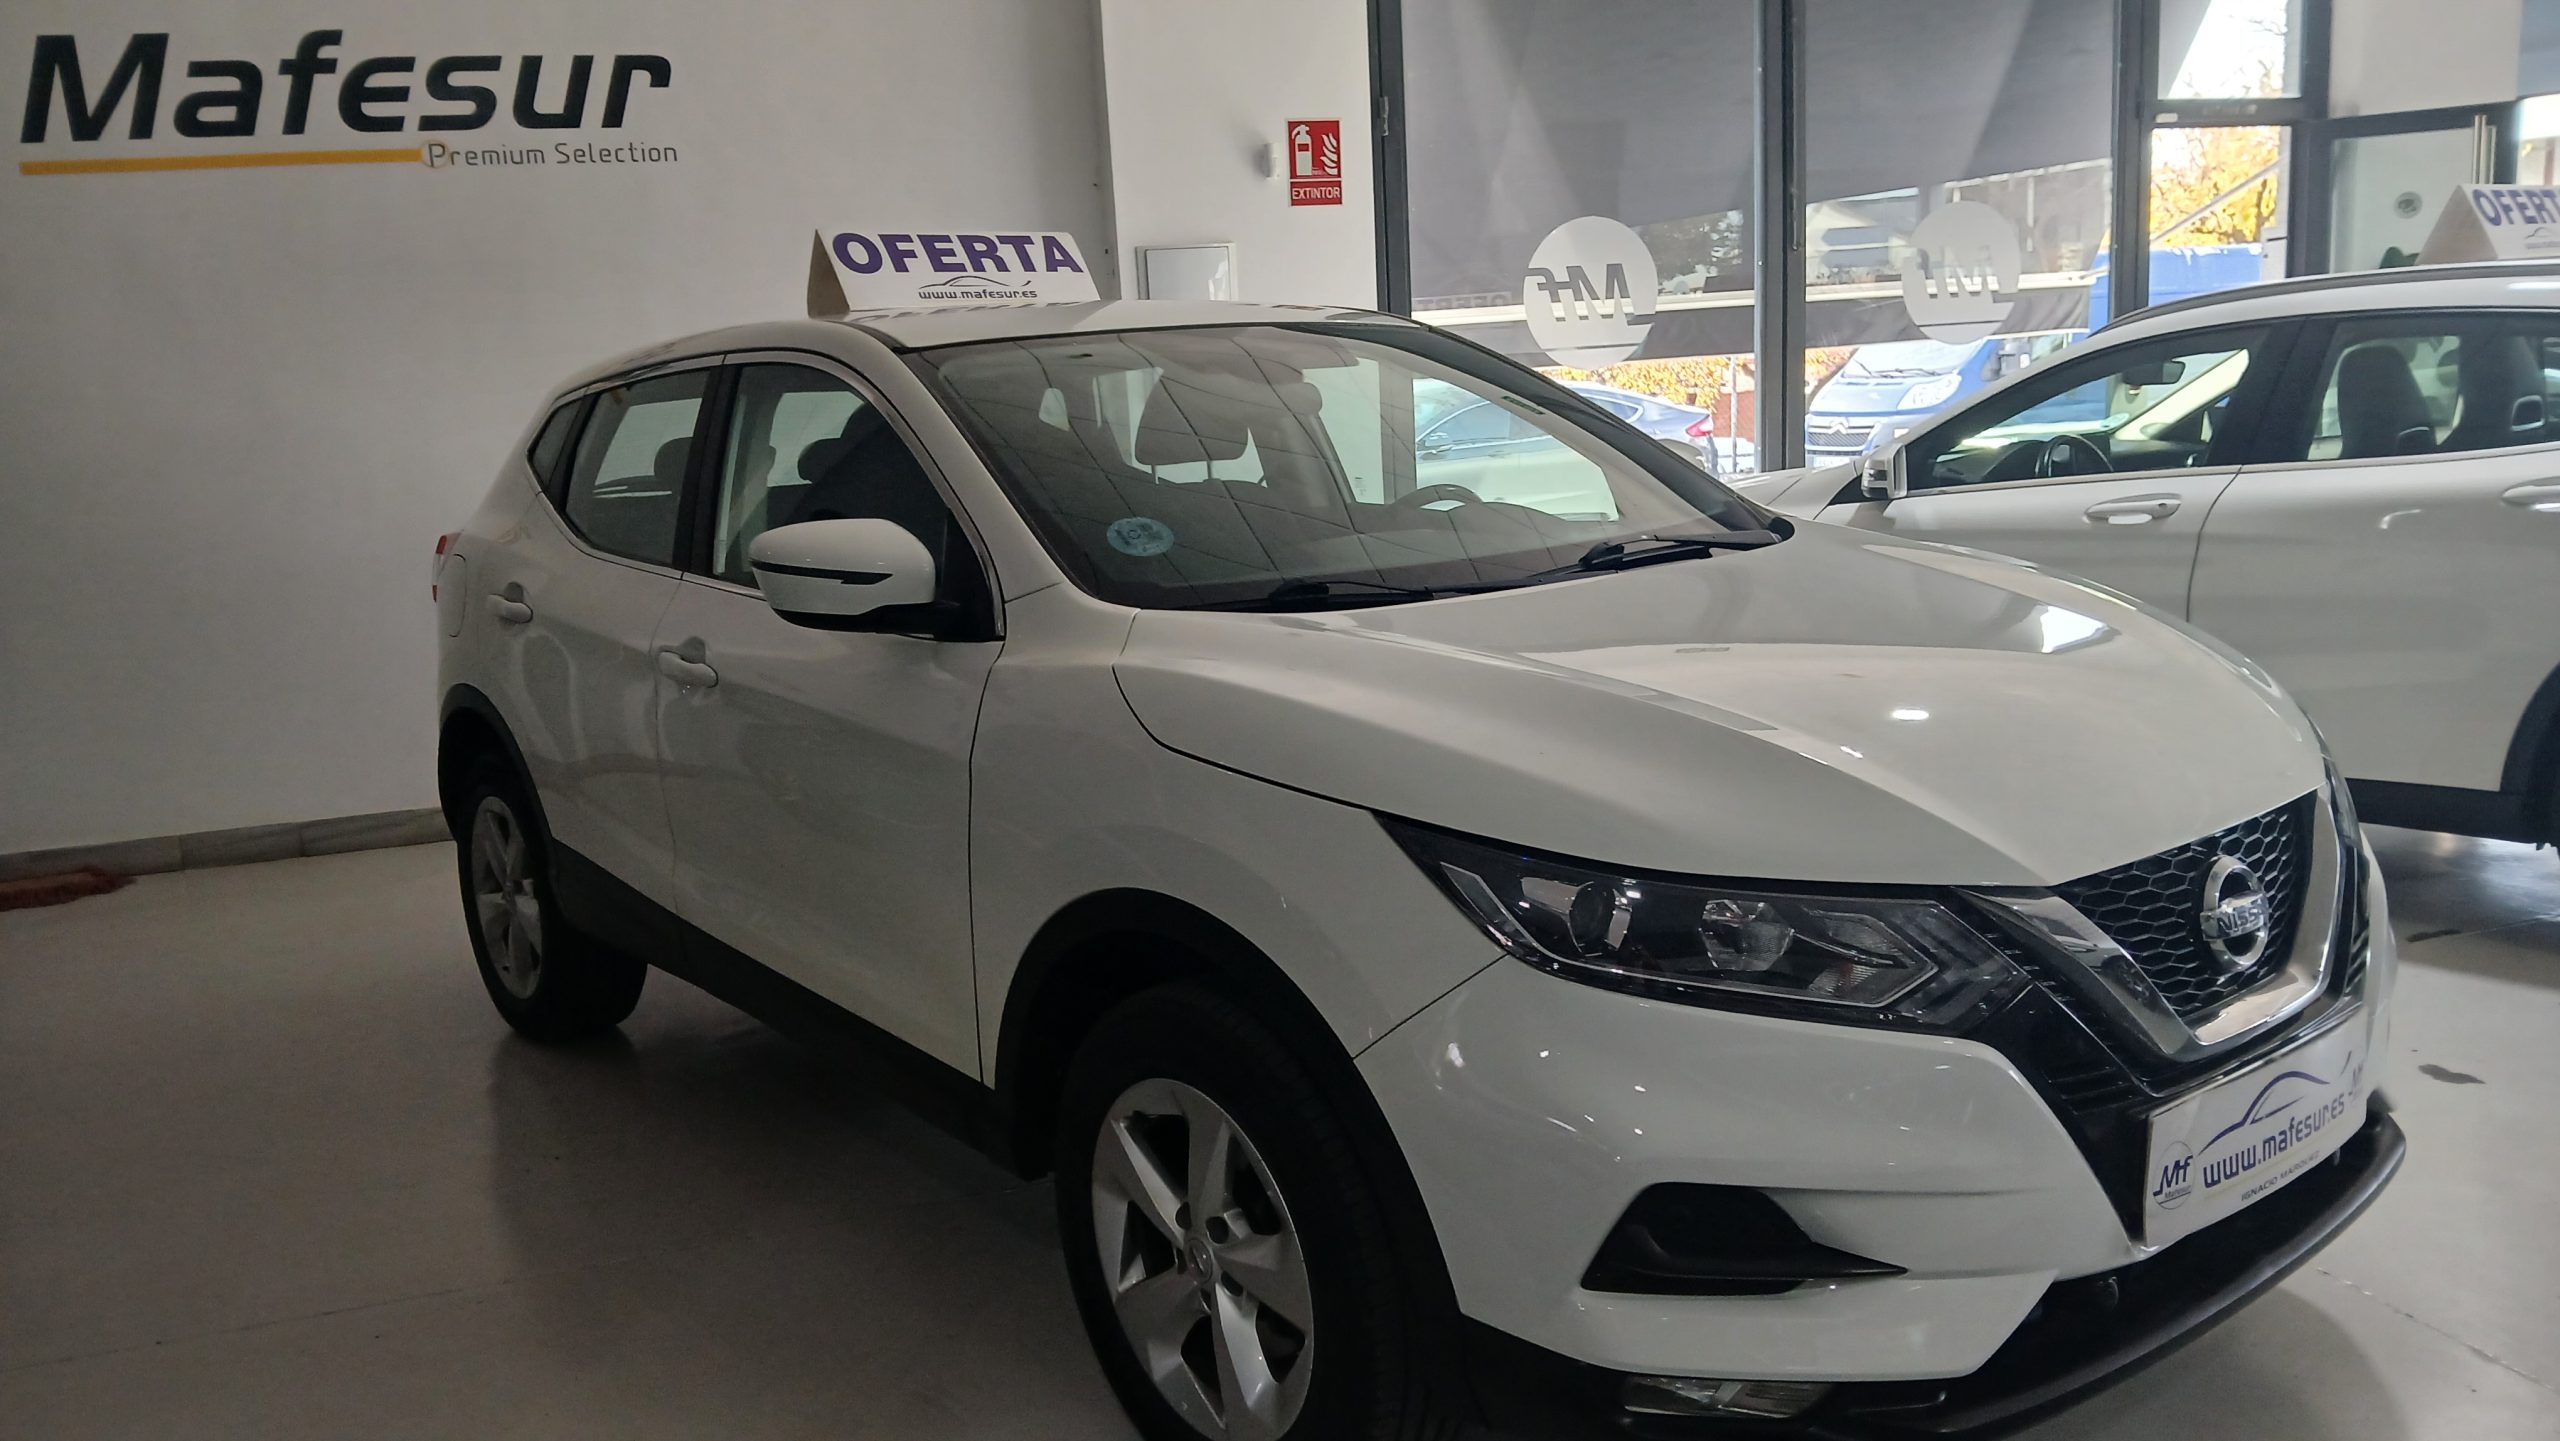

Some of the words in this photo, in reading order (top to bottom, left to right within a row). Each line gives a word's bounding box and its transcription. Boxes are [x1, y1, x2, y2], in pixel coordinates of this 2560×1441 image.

[20, 29, 673, 144] Mafesur
[428, 143, 545, 168] Premium
[554, 142, 678, 165] Selection
[1292, 187, 1341, 200] EXTINTOR
[832, 232, 1084, 275] OFERTA
[918, 288, 1038, 300] www.mafesur.es
[2203, 1093, 2345, 1189] www.mafesur.es
